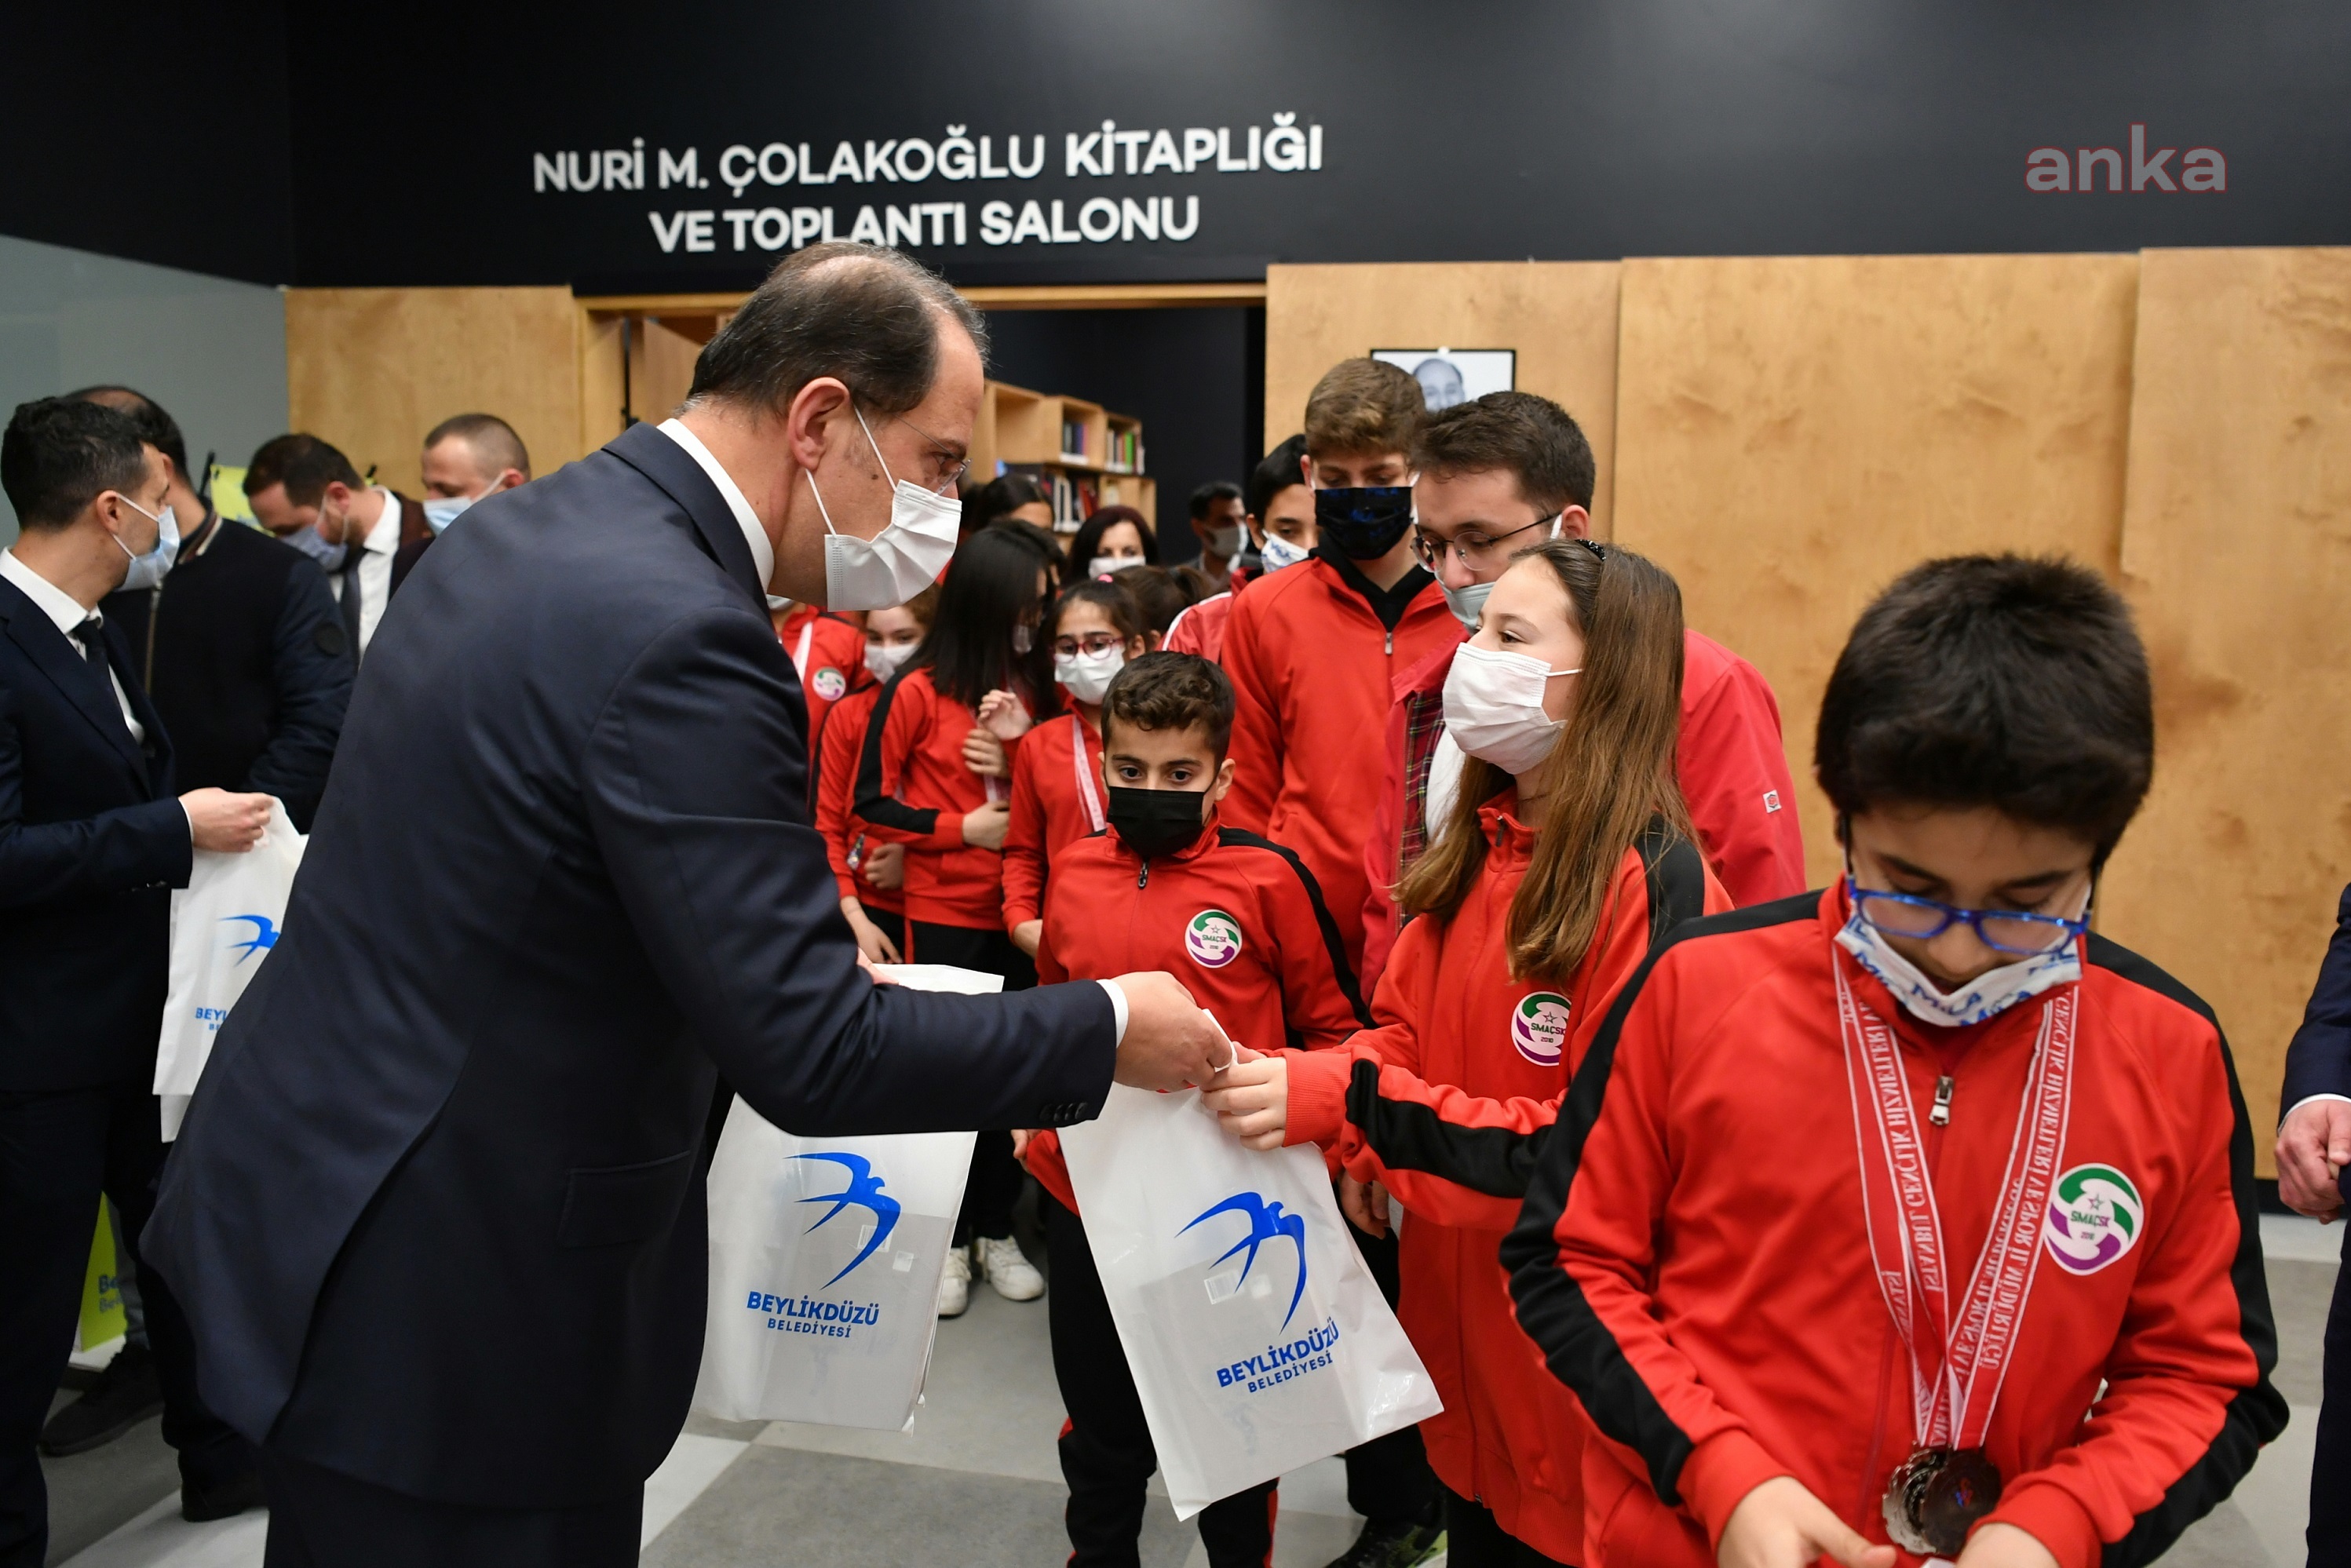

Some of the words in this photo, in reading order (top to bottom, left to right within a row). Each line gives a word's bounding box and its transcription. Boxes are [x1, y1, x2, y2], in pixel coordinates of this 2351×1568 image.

[535, 137, 644, 191] NURİ
[659, 148, 709, 189] M.
[719, 124, 1046, 198] ÇOLAKOĞLU
[1065, 111, 1323, 177] KİTAPLIĞI
[648, 210, 715, 253] VE
[722, 202, 967, 252] TOPLANTI
[980, 195, 1199, 245] SALONU
[747, 1291, 879, 1326] BEYLİKDÜZÜ
[767, 1318, 852, 1338] BELEDİYESİ
[1216, 1316, 1339, 1387] BEYLİKDÜZÜ
[1247, 1350, 1333, 1393] BELEDİYESİ
